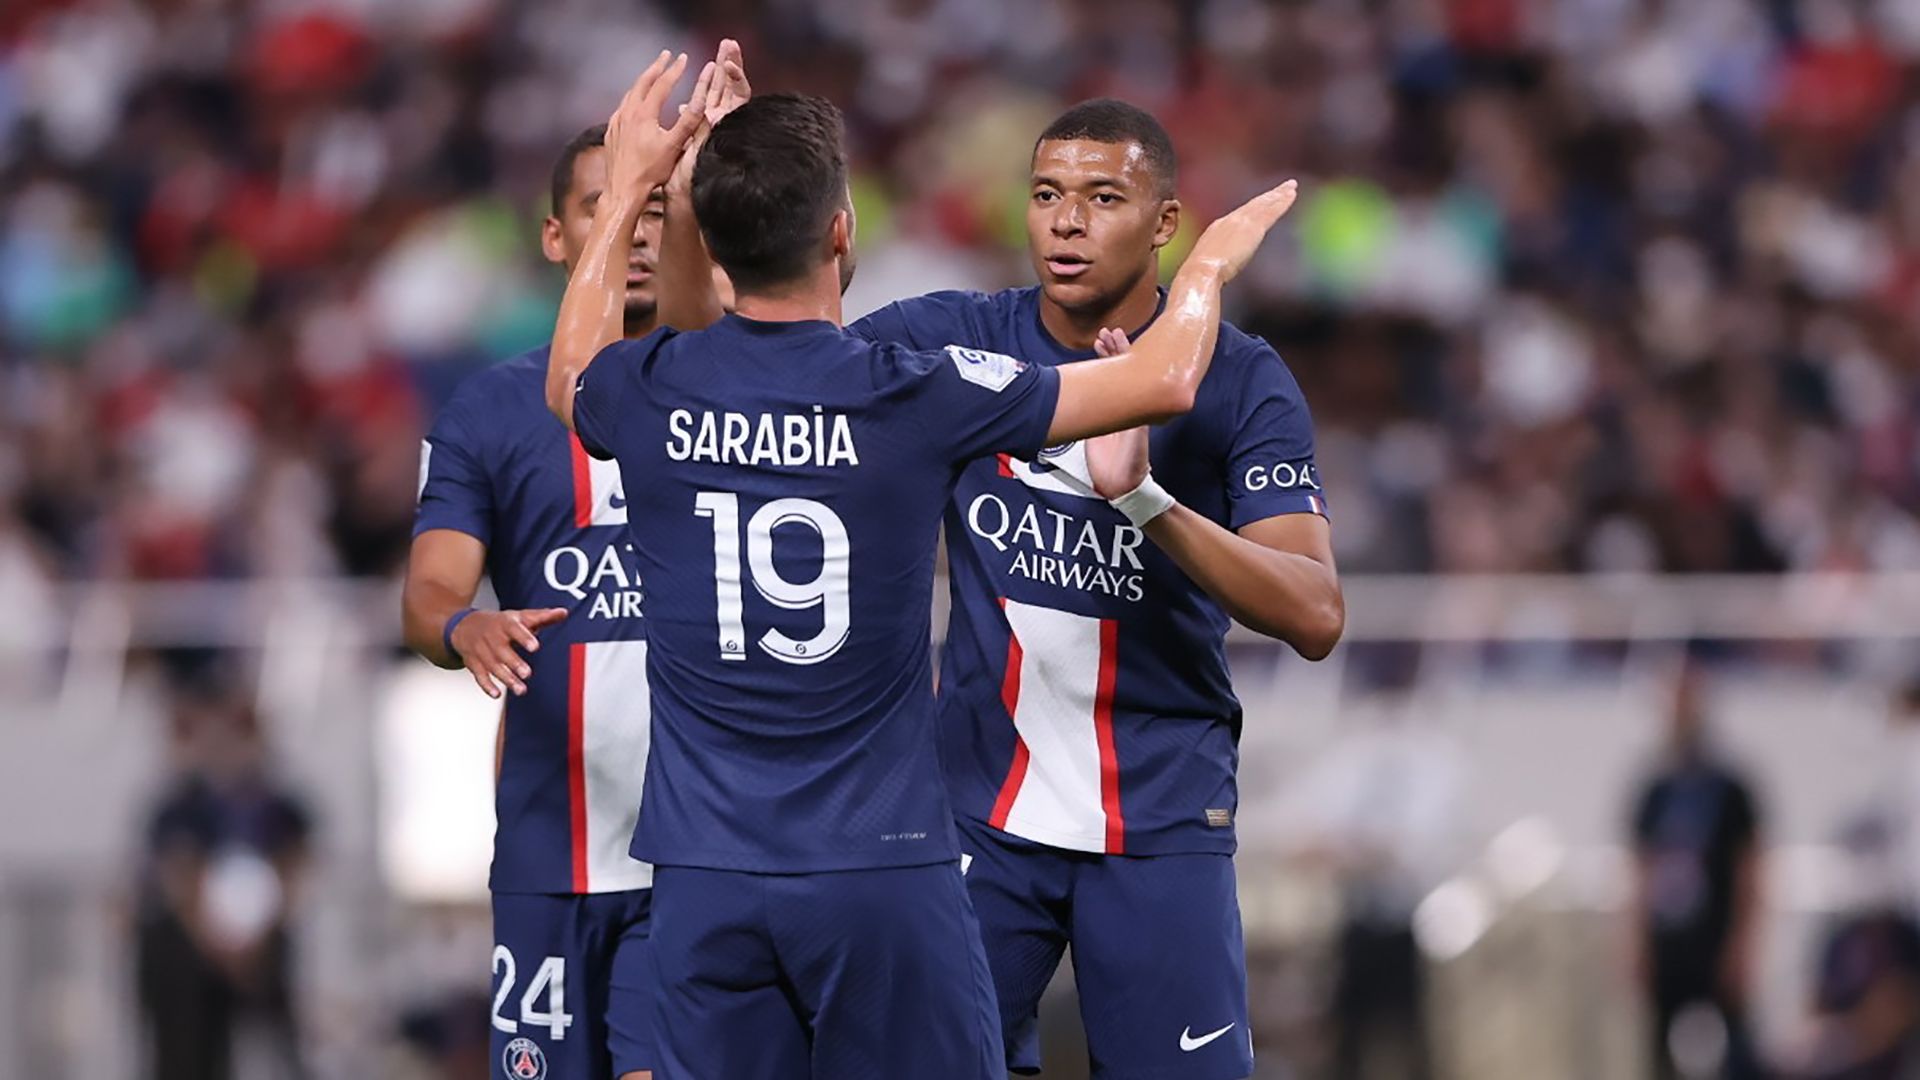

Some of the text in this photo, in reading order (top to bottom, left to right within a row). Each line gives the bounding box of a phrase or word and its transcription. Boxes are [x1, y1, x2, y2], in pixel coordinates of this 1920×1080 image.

[1245, 462, 1321, 491] GOA
[968, 493, 1145, 570] QATAR
[543, 543, 642, 600] QA
[694, 491, 850, 665] 19
[1008, 551, 1144, 602] AIRWAYS
[491, 944, 573, 1040] 24
